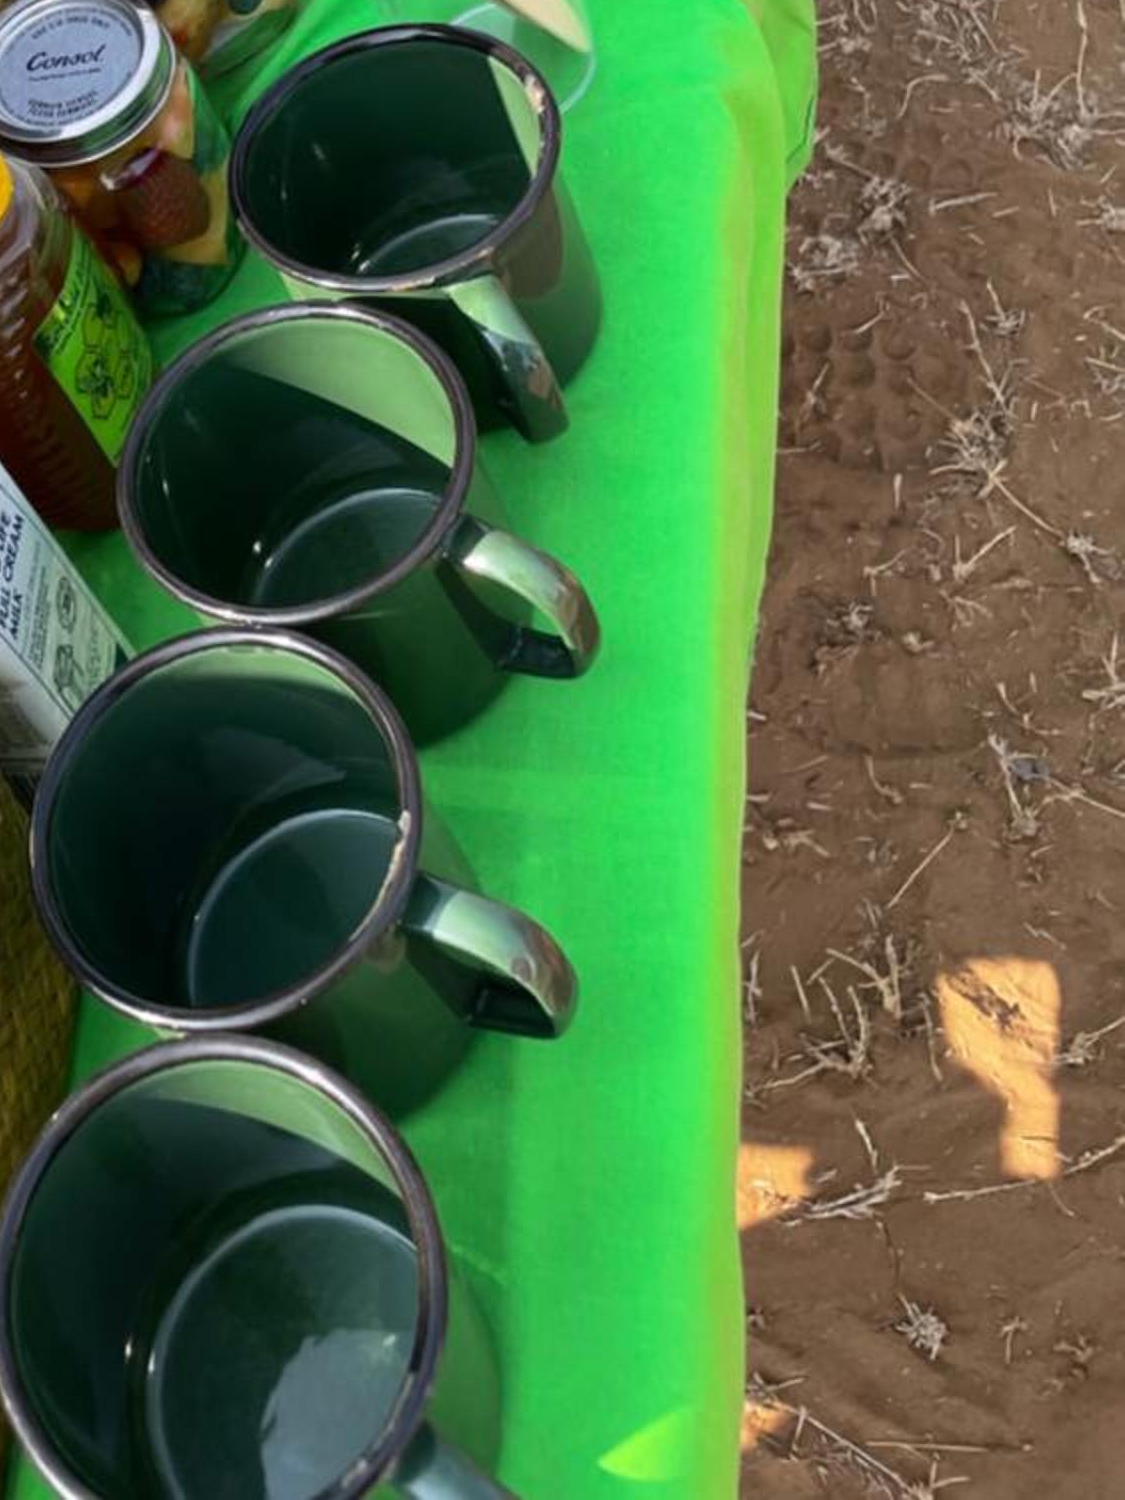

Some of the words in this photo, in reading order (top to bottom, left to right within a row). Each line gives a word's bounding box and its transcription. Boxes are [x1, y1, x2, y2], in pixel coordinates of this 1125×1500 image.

[26, 43, 106, 72] Consol
[2, 514, 25, 583] CREAM
[9, 590, 24, 641] MILK
